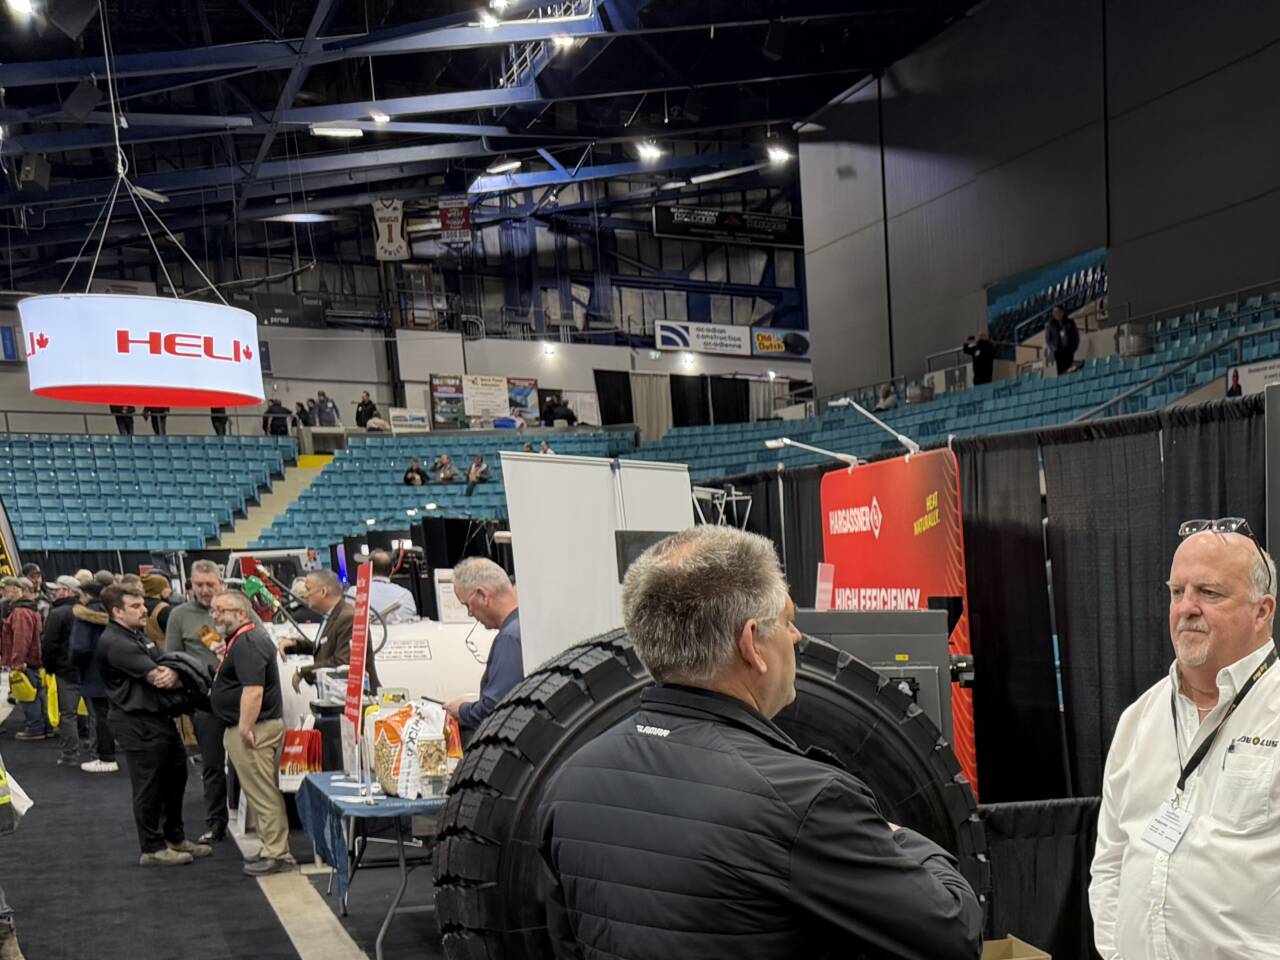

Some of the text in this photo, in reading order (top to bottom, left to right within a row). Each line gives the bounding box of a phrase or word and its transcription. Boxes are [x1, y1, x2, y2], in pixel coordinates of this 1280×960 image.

[116, 329, 241, 363] HELI
[829, 505, 871, 535] HARGASSNER
[835, 588, 920, 610] HIGH EFFICIENCY
[1237, 735, 1280, 748] AEOLUS
